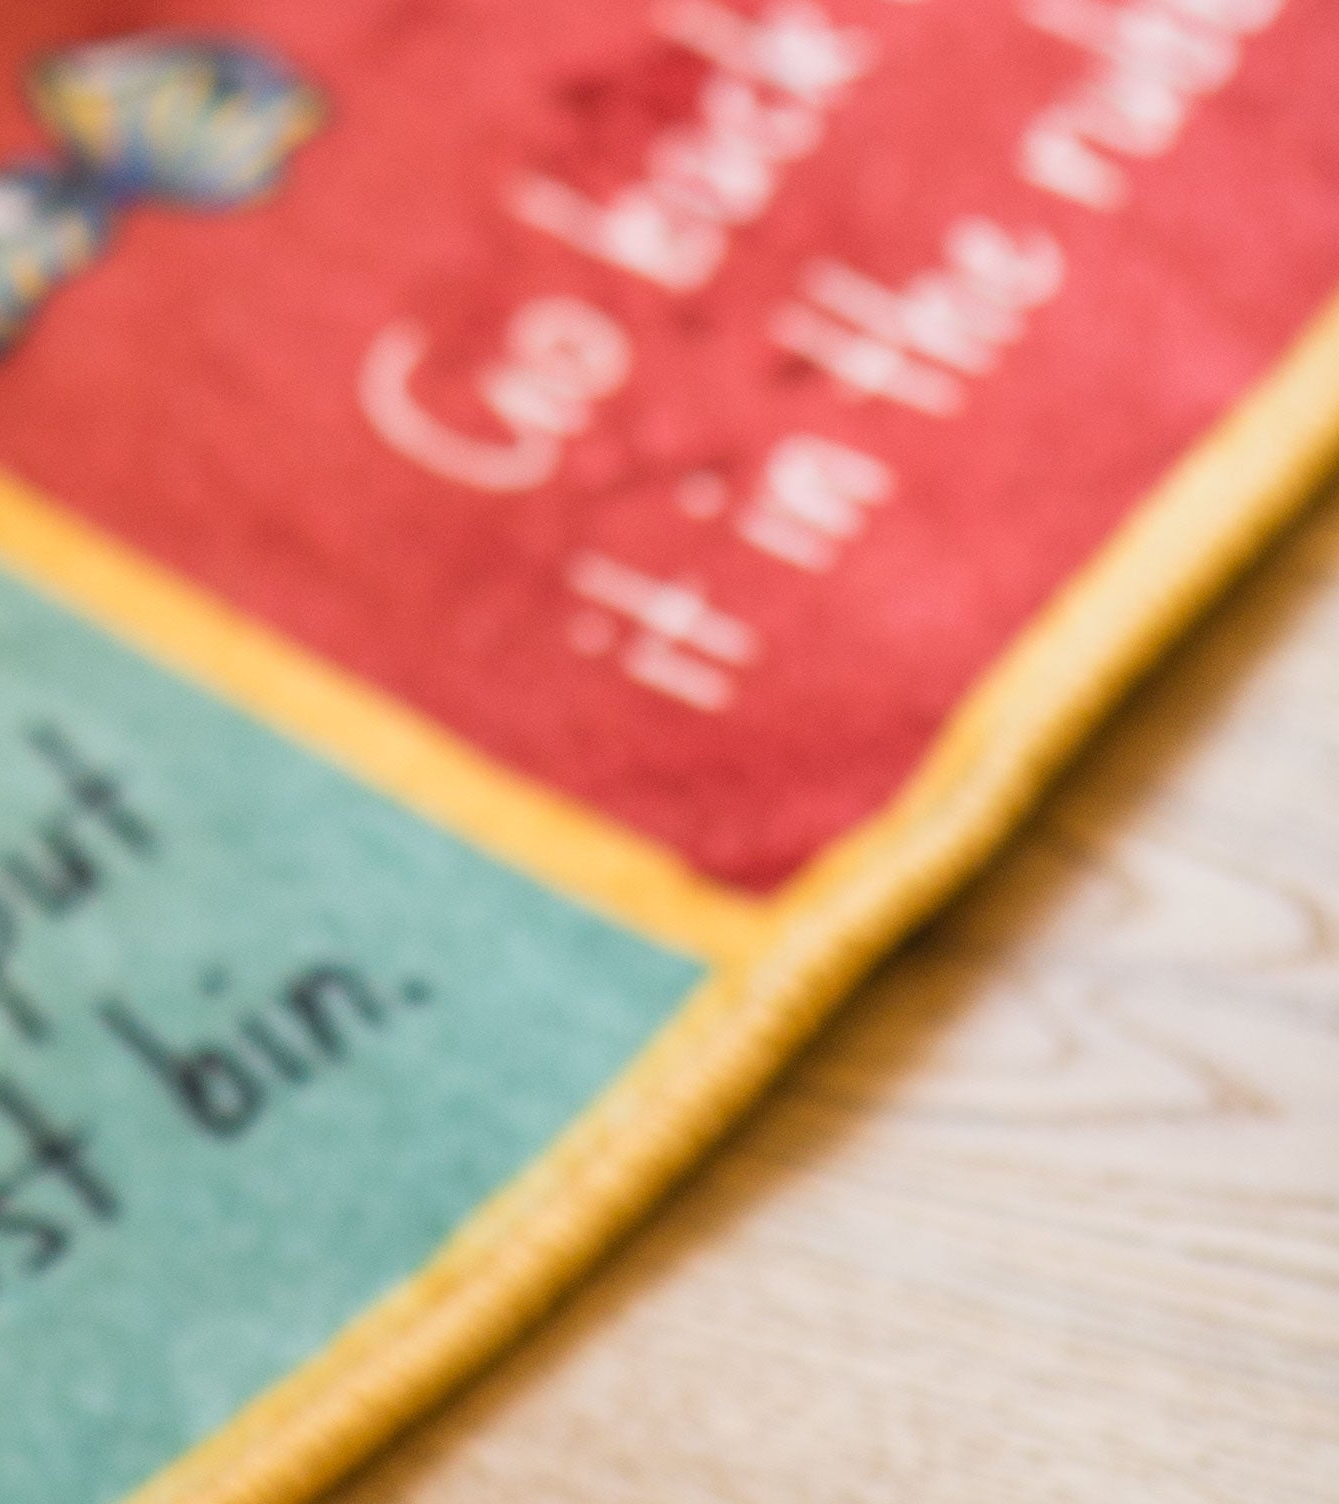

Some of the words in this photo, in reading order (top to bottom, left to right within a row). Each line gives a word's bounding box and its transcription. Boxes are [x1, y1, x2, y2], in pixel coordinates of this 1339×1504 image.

[357, 296, 633, 493] Go
[768, 216, 1066, 419] the
[675, 433, 896, 575] in
[563, 546, 763, 714] it
[95, 960, 433, 1142] bin.
